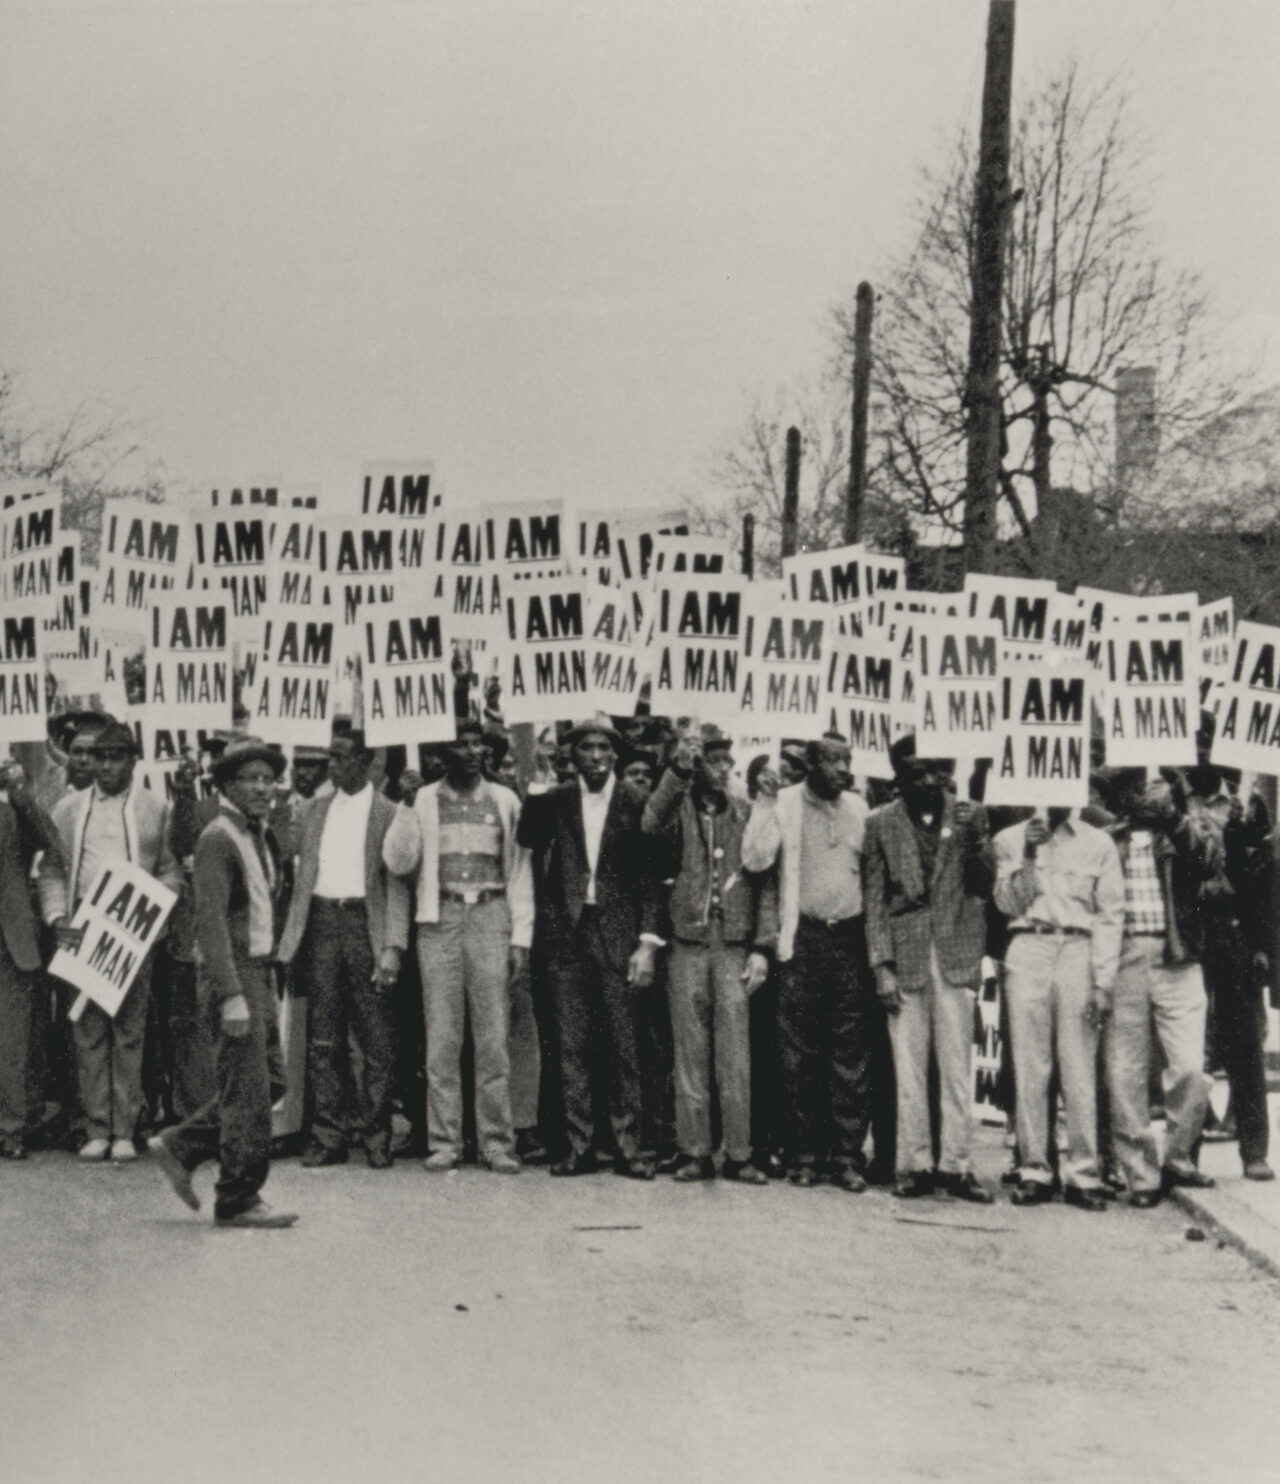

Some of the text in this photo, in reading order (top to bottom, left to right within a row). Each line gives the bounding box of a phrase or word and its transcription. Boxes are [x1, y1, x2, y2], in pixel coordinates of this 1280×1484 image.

[363, 475, 430, 514] I AM
[11, 509, 53, 551] AM
[108, 516, 179, 562] I AM
[196, 523, 204, 564] I
[214, 520, 264, 562] AM
[320, 531, 326, 571] I
[337, 530, 392, 571] AM
[436, 523, 445, 561] I
[487, 519, 495, 560] I
[505, 515, 560, 559] AM
[102, 567, 115, 604] A
[791, 573, 798, 601] I
[810, 561, 860, 602] AM
[153, 606, 226, 648] I AM
[507, 598, 516, 640] I
[527, 593, 583, 639] AM
[660, 589, 669, 632] I
[678, 591, 740, 635] AM
[989, 594, 1048, 640] AM
[1201, 610, 1229, 641] AM
[278, 622, 333, 664] AM
[367, 616, 442, 663] I AM
[745, 616, 753, 656] I
[763, 617, 823, 660] AM
[921, 635, 997, 676] I AM
[513, 650, 587, 696] A MAN
[593, 652, 637, 693] MAN
[658, 648, 737, 692] A MAN
[828, 652, 892, 699] I AM
[1108, 640, 1183, 681] I AM
[1233, 639, 1248, 681] I
[152, 662, 226, 703] A MAN
[258, 677, 328, 719] A MAN
[372, 673, 446, 719] A MAN
[742, 673, 818, 714] A MAN
[1003, 677, 1084, 721] I AM
[851, 710, 890, 751] MAN
[923, 691, 936, 731] A
[1113, 697, 1187, 738] A MAN
[1222, 698, 1238, 738] A
[1001, 736, 1082, 779] A MAN
[91, 870, 162, 941] I AM
[88, 930, 138, 988] MAN
